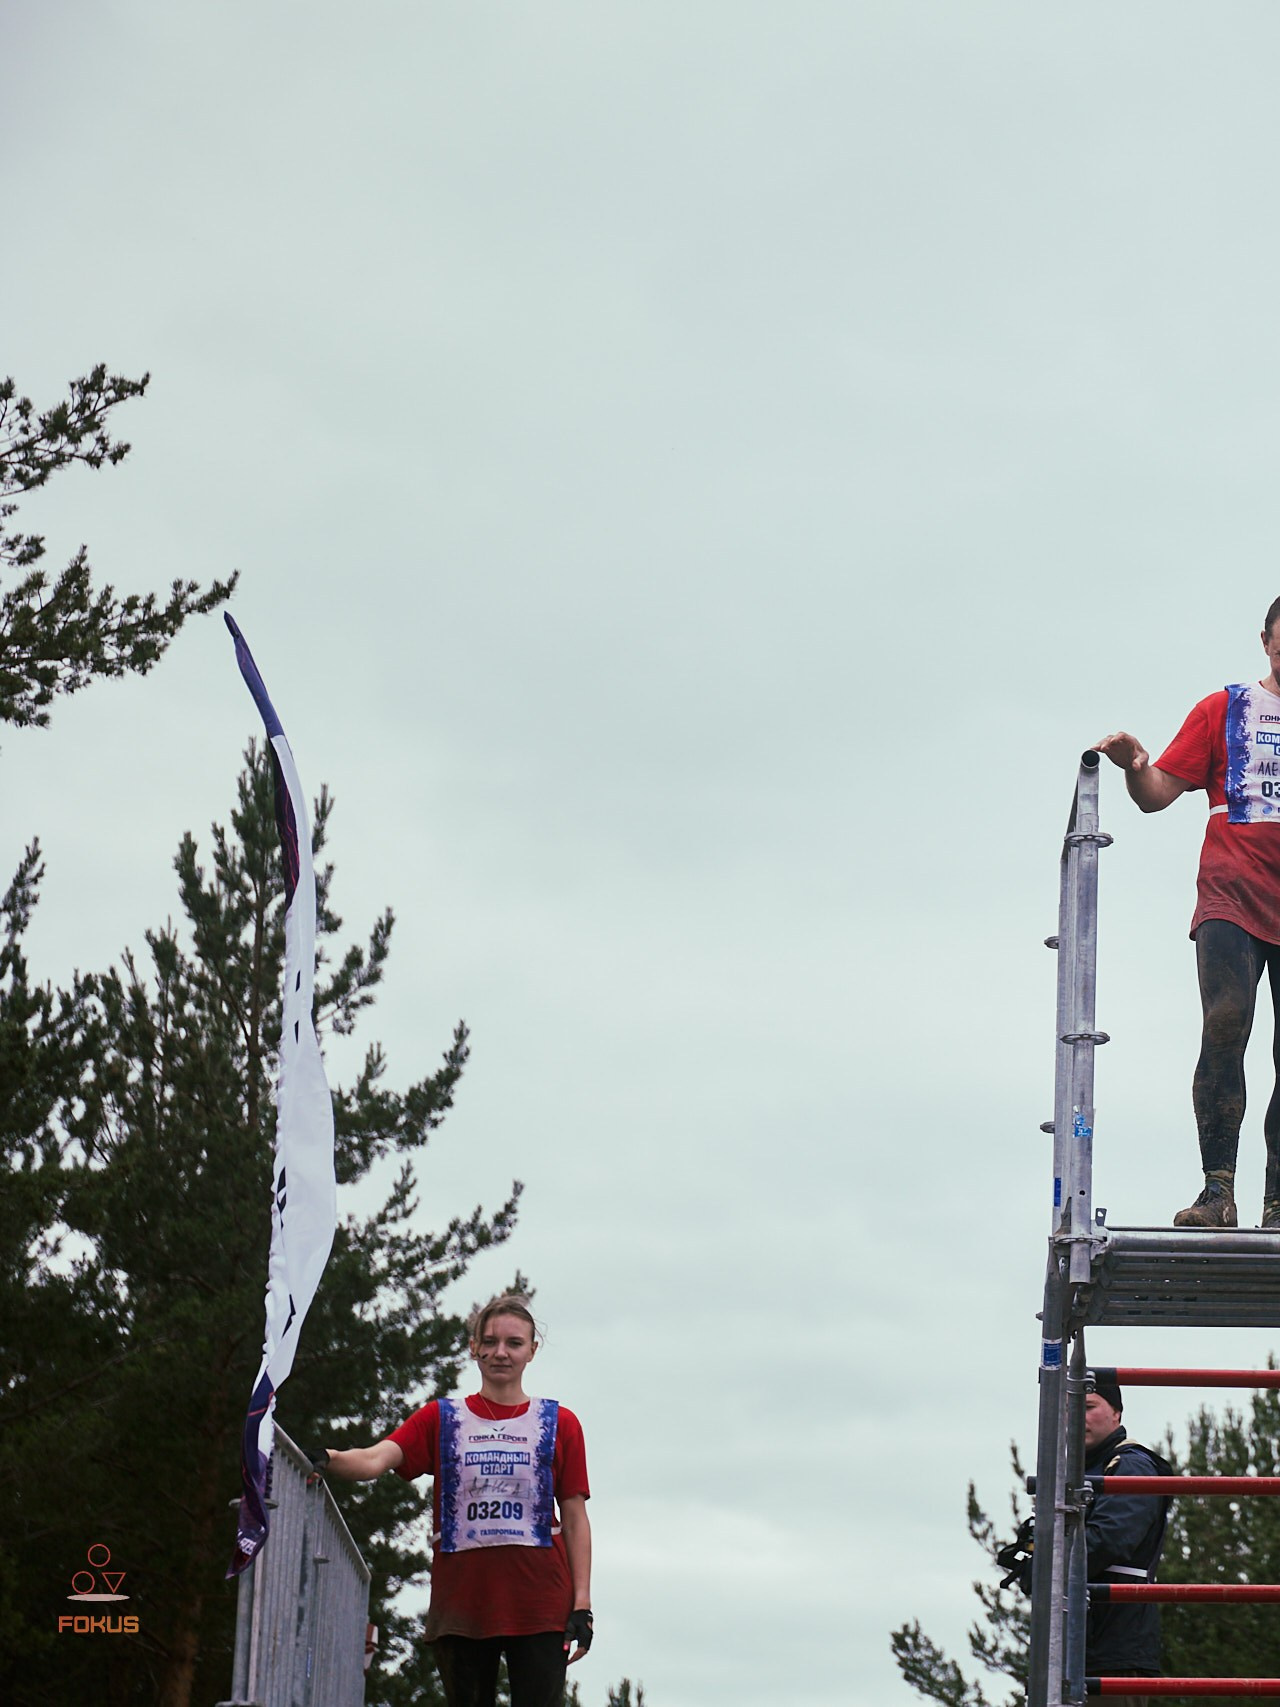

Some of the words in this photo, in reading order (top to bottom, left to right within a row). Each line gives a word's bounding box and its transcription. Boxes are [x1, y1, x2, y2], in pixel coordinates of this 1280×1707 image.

[497, 1433, 528, 1442] ГЕРОЕВ
[466, 1451, 529, 1465] КОМАНДНЫЙ
[482, 1463, 512, 1475] СТАРТ
[467, 1500, 523, 1521] 03209
[480, 1528, 525, 1537] ГАЗПРОМБАНК
